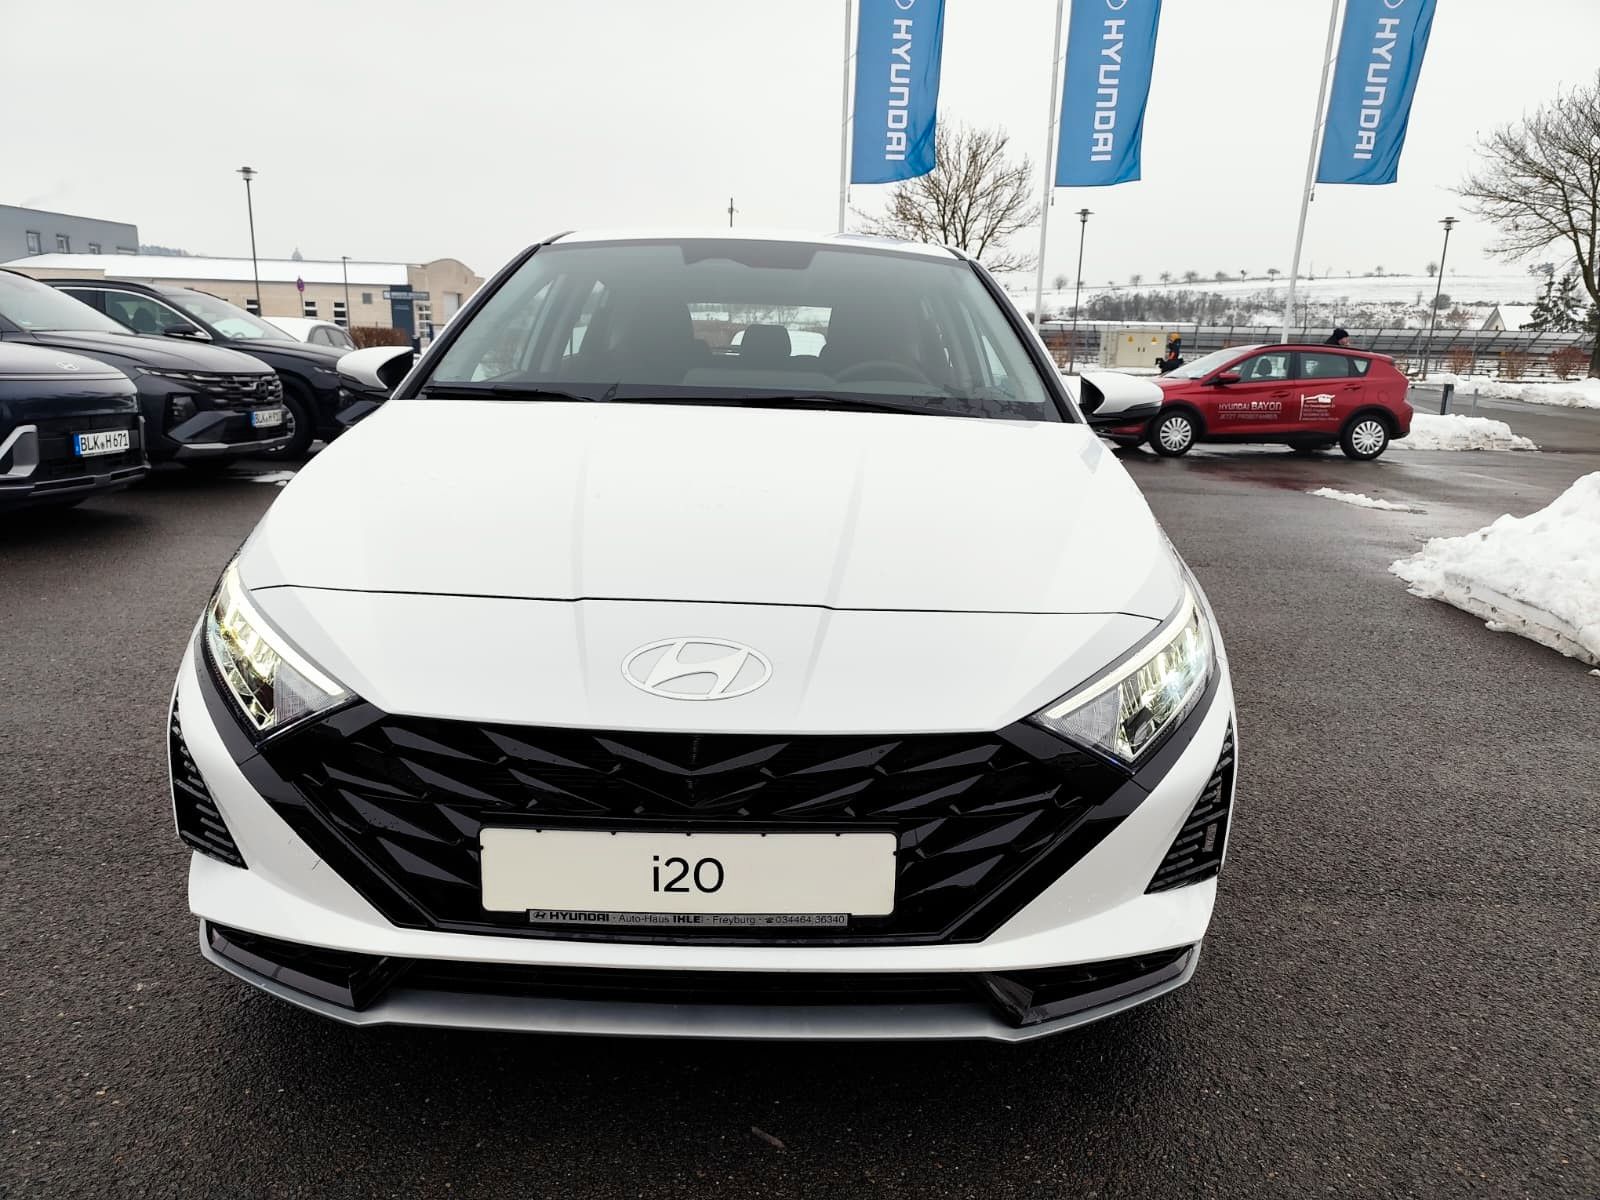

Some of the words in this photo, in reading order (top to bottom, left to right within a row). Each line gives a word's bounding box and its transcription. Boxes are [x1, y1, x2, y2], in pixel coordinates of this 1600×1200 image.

[885, 19, 913, 160] HYUNDAI
[1091, 19, 1126, 161] HYUNDAI
[1353, 18, 1400, 160] HYUNDAI
[1251, 401, 1282, 411] BAYON
[80, 435, 100, 451] BLK
[106, 434, 112, 448] H
[113, 433, 128, 447] 671
[653, 855, 724, 893] i20
[549, 911, 610, 922] HYUNDAI
[618, 914, 670, 924] Auto-Haus
[673, 915, 700, 924] IHLE
[712, 915, 756, 926] Freyburg
[775, 916, 812, 924] 034464
[815, 916, 845, 924] 36340
